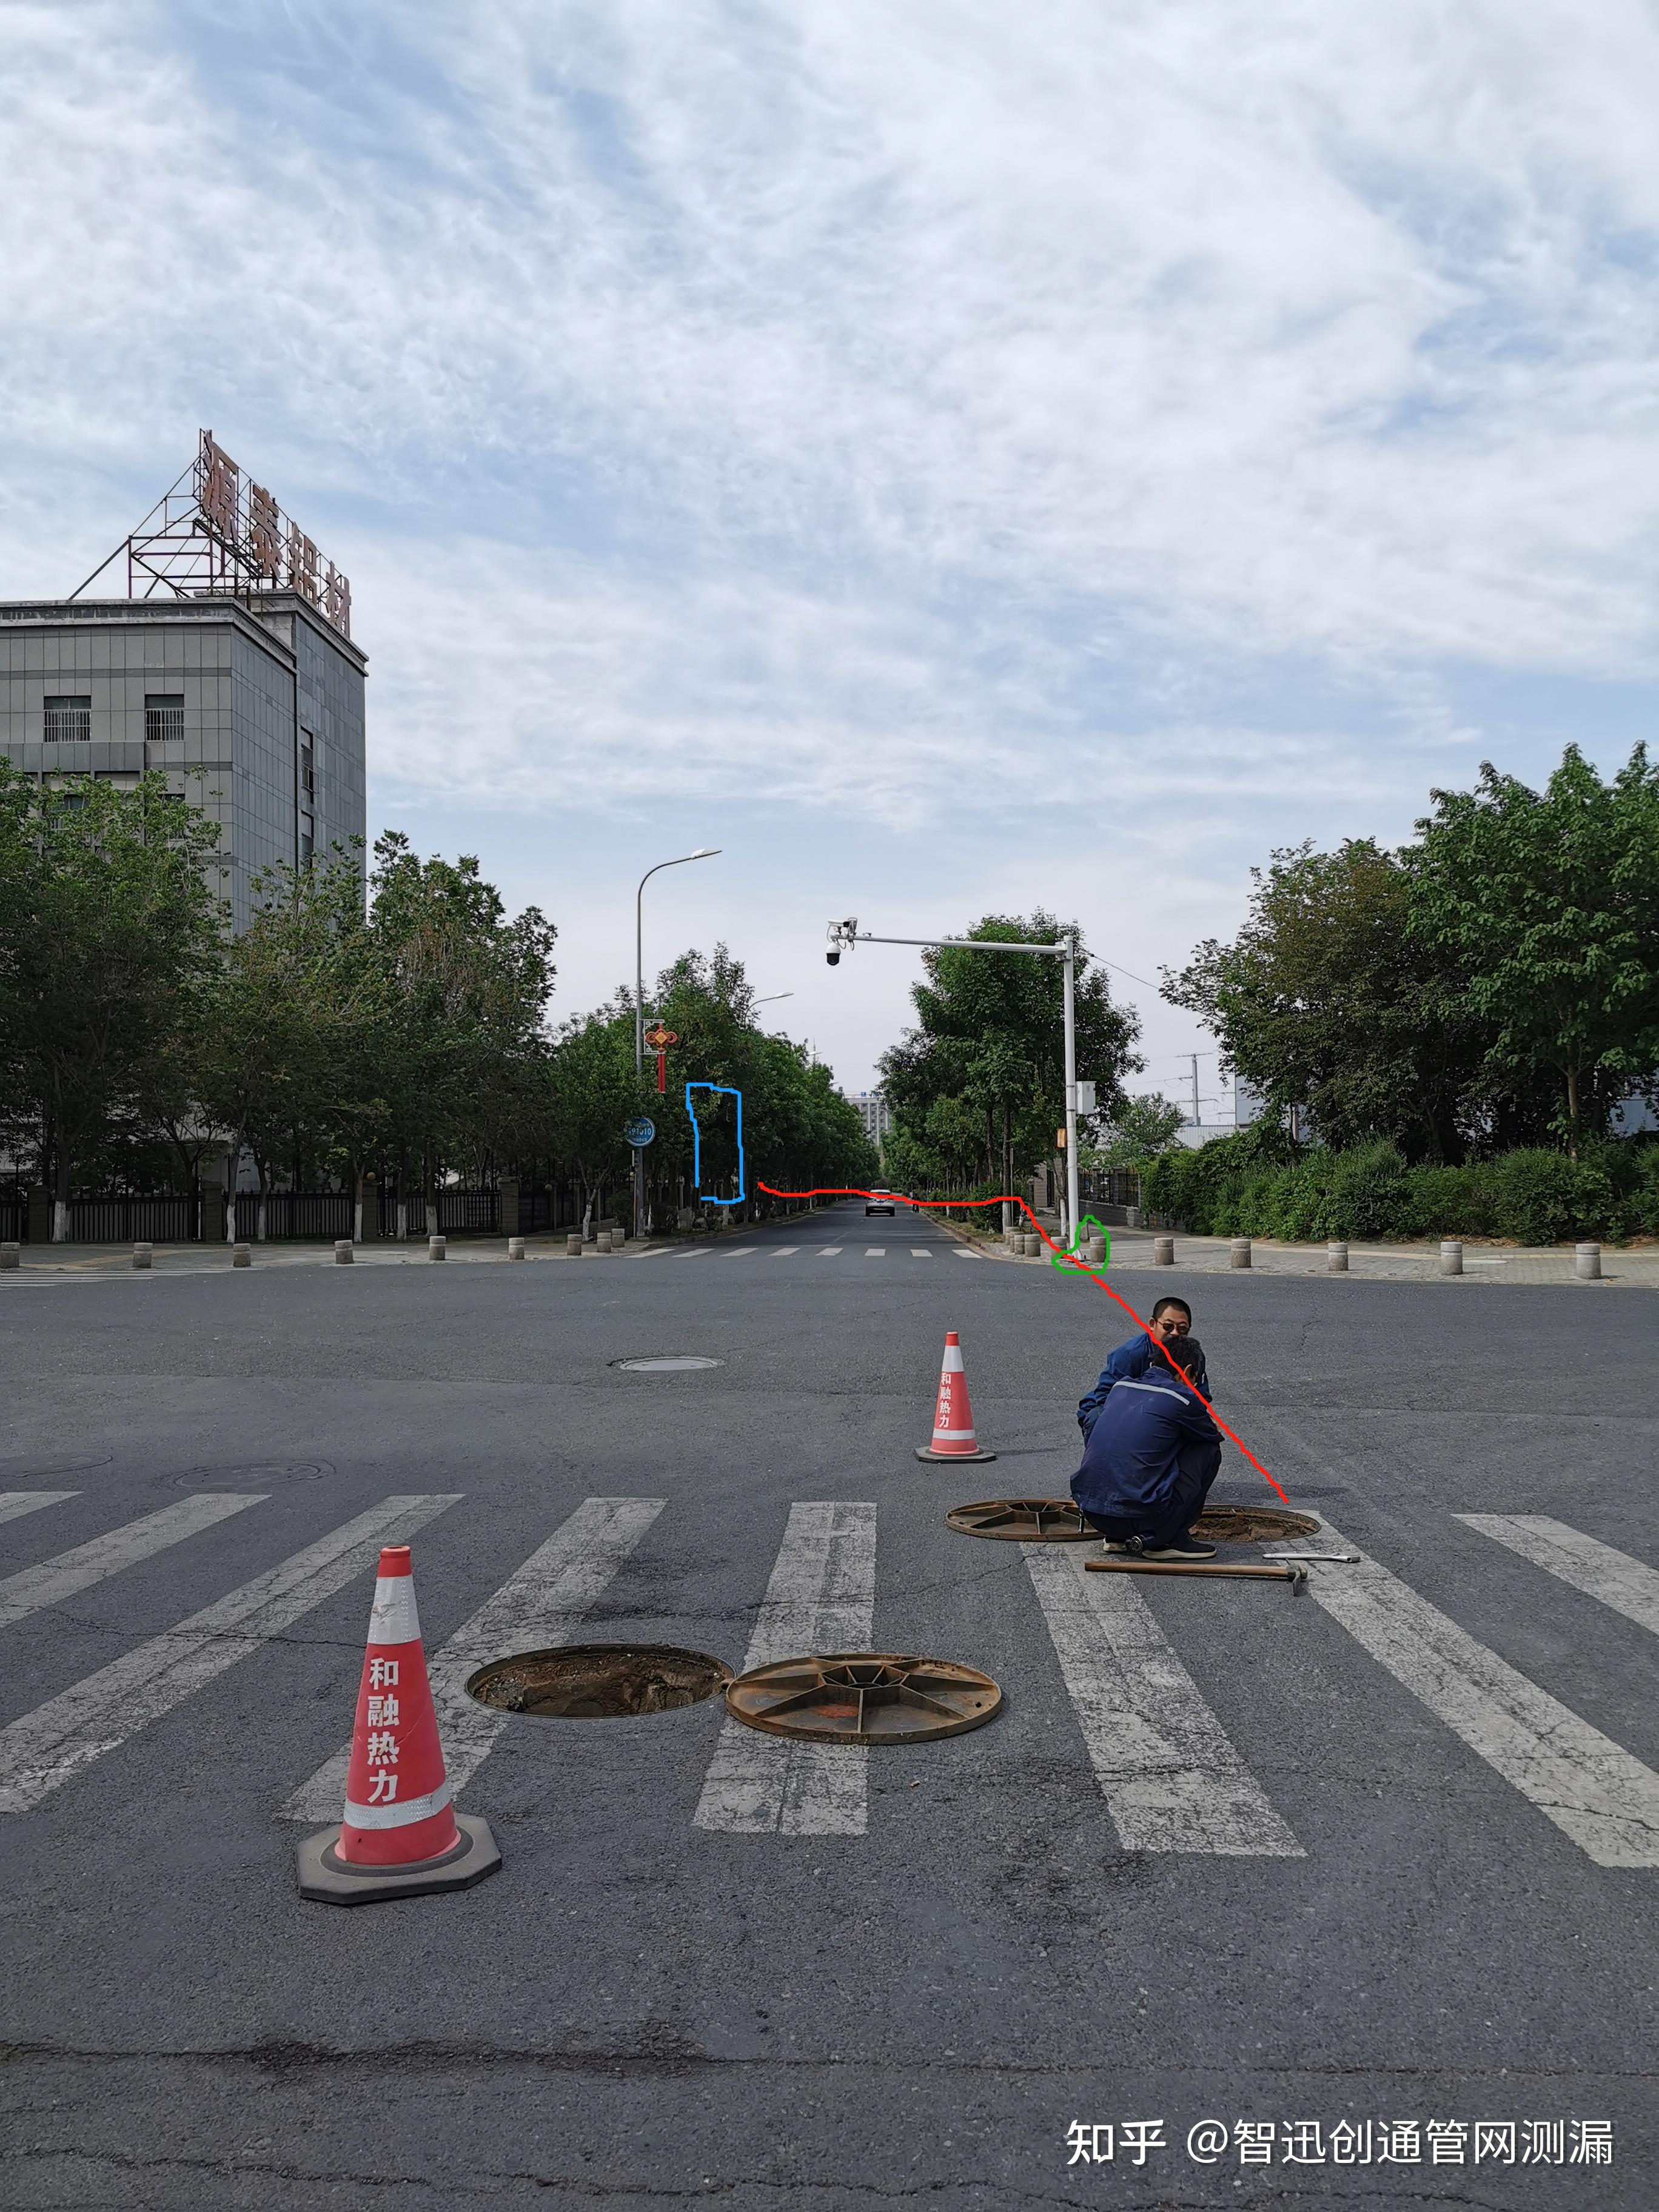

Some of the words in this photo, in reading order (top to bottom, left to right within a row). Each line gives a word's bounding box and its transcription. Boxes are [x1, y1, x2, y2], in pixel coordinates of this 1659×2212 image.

[939, 1373, 951, 1428] 和融热力
[367, 1657, 400, 1803] 和融热力
